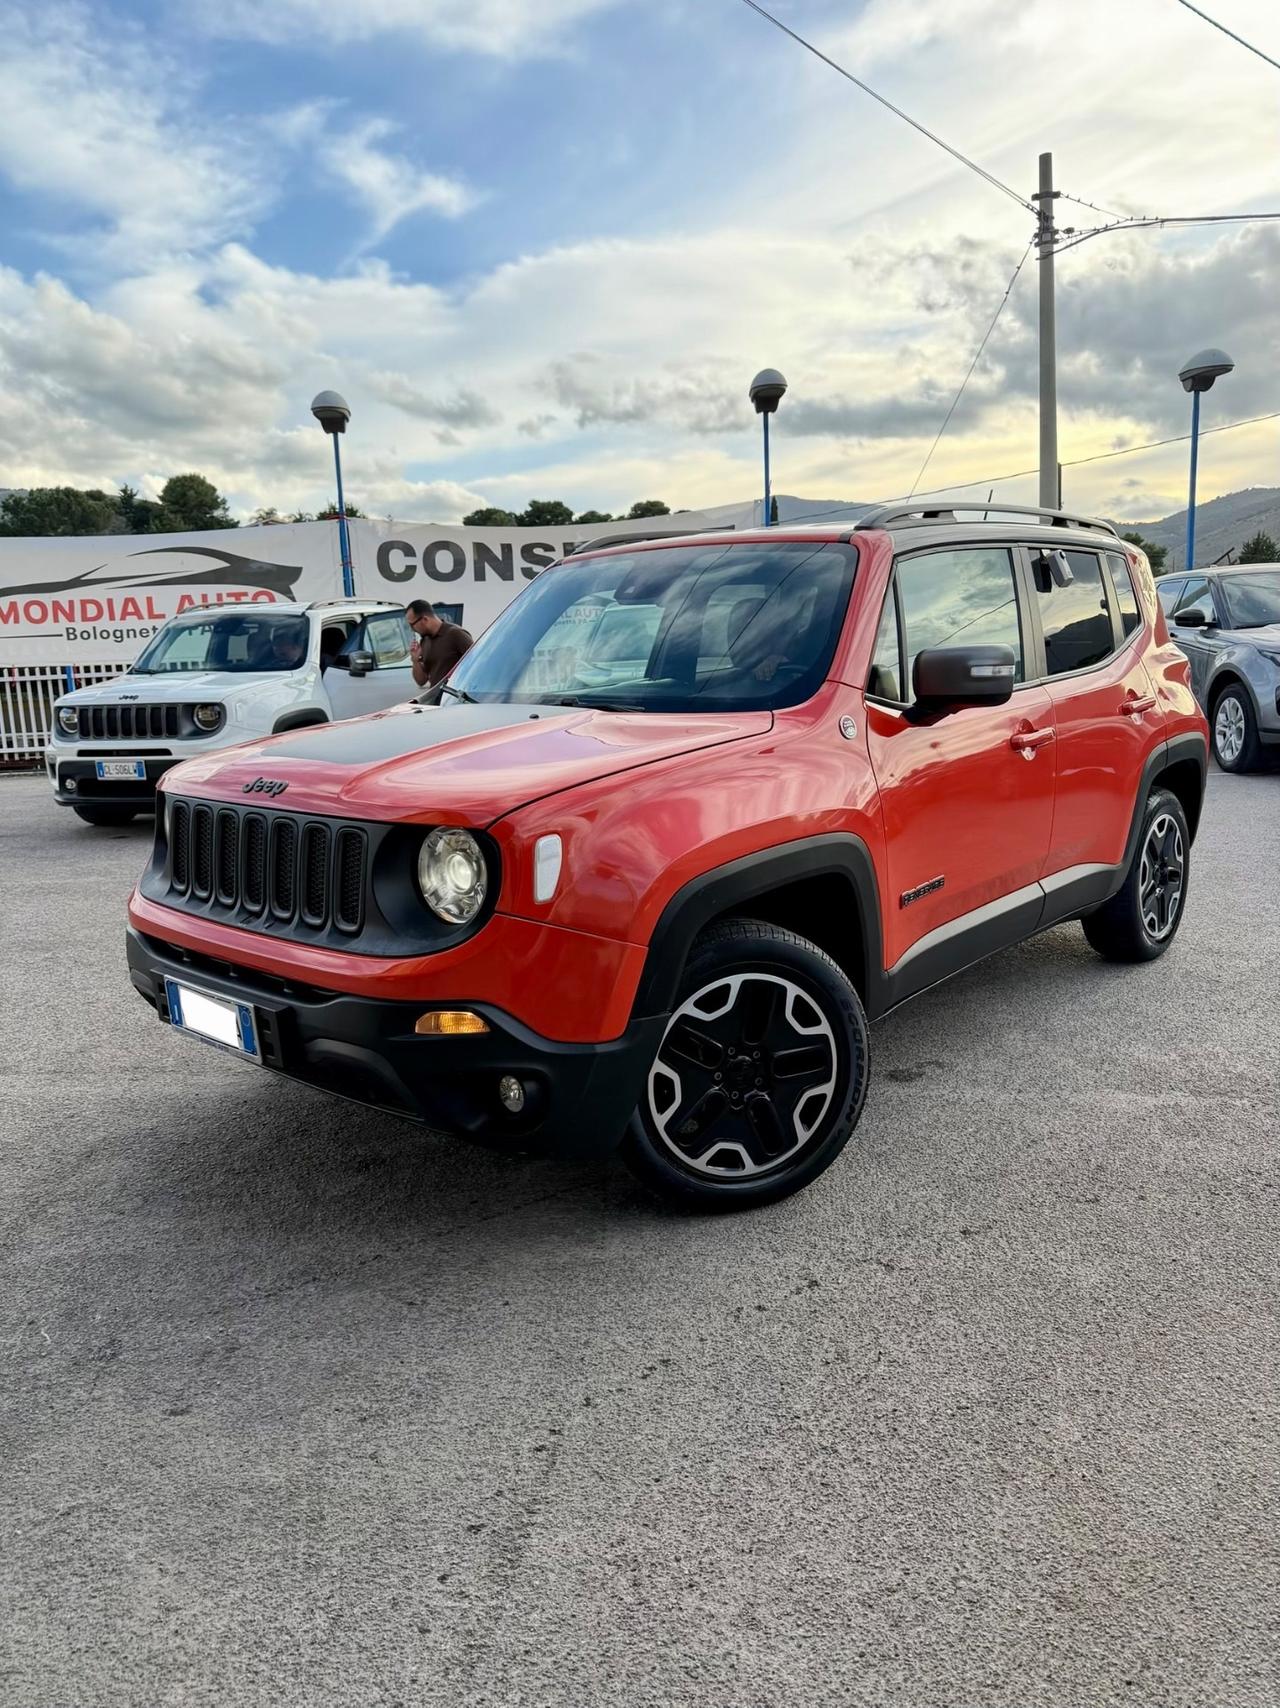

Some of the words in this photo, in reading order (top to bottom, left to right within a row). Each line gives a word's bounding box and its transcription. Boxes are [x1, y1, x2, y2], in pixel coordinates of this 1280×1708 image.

[376, 540, 591, 582] CONS
[0, 596, 165, 624] MONDIAL
[242, 777, 288, 798] Jeep
